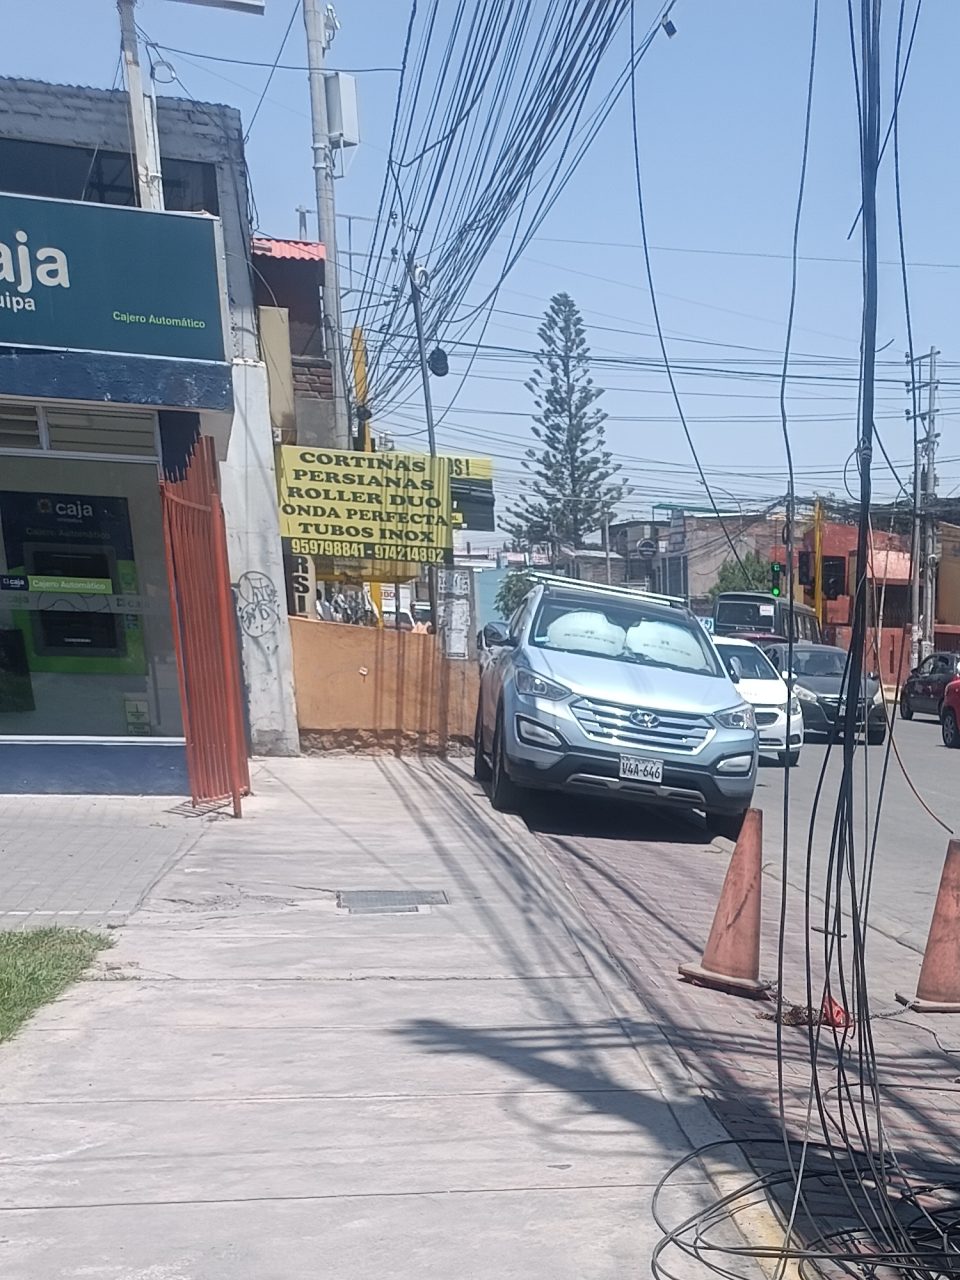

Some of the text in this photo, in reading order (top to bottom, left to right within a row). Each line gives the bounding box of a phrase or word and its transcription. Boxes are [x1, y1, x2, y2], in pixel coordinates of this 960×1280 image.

[113, 311, 206, 329] Cajero Automático
[299, 452, 426, 472] CORTINAS
[292, 469, 434, 491] PERSIANAS
[287, 486, 441, 508] ROLLER DUO
[56, 501, 93, 518] caja
[282, 503, 449, 527] ONDA PERFECTA
[298, 522, 435, 543] TUBOS INOX
[291, 538, 365, 558] 959798841
[374, 545, 444, 563] 974214892
[32, 580, 59, 589] Cajero
[622, 761, 661, 779] V4A-646
